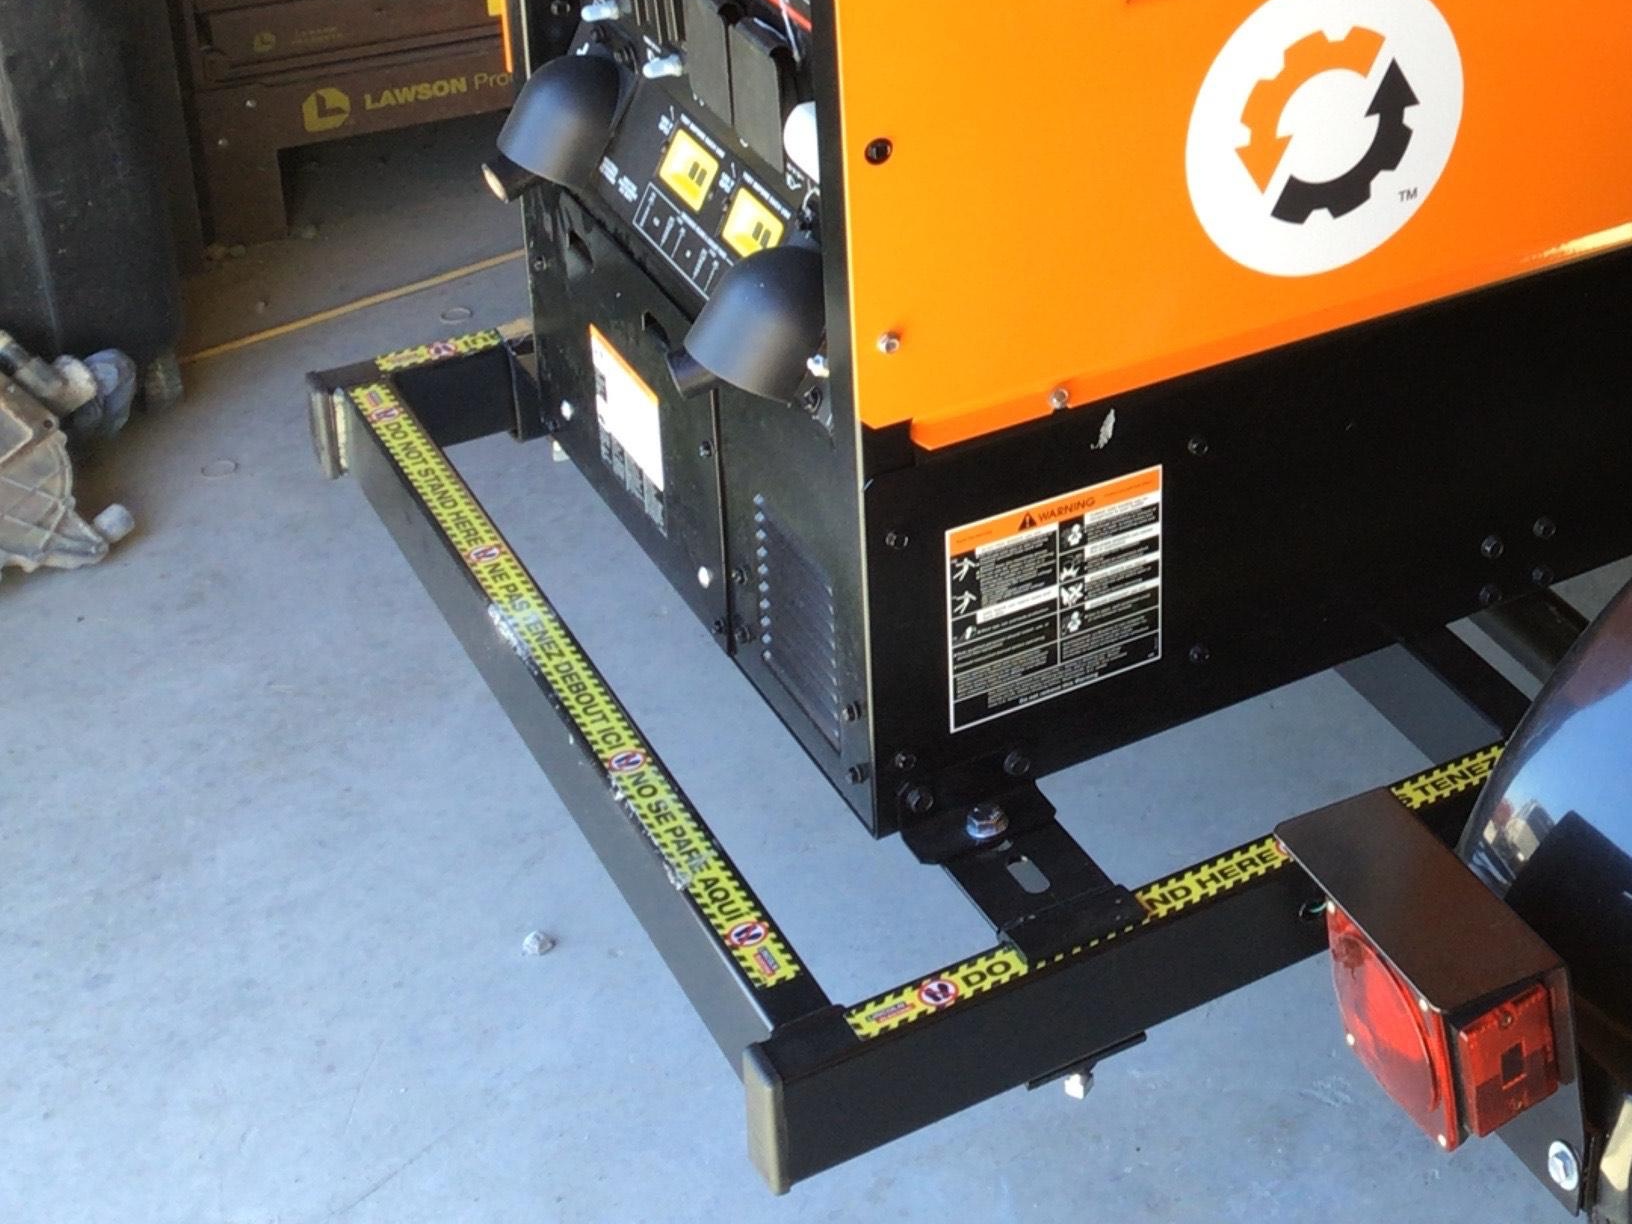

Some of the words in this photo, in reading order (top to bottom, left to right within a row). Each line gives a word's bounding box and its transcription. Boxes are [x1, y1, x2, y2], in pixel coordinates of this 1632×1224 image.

[364, 77, 468, 111] LAWSON
[1398, 187, 1418, 202] TM
[386, 421, 409, 441] DO
[402, 441, 429, 468] NOT
[417, 467, 459, 510] STAND
[450, 510, 486, 548] HERE
[1038, 496, 1097, 523] WARNING
[485, 561, 511, 584] NE
[502, 582, 532, 613] PAS
[553, 661, 611, 725] DEBOUT
[597, 725, 627, 751] ICI
[630, 771, 659, 799] NO
[648, 798, 677, 826] SE
[1199, 847, 1277, 886] HERE
[960, 960, 1012, 988] DO
